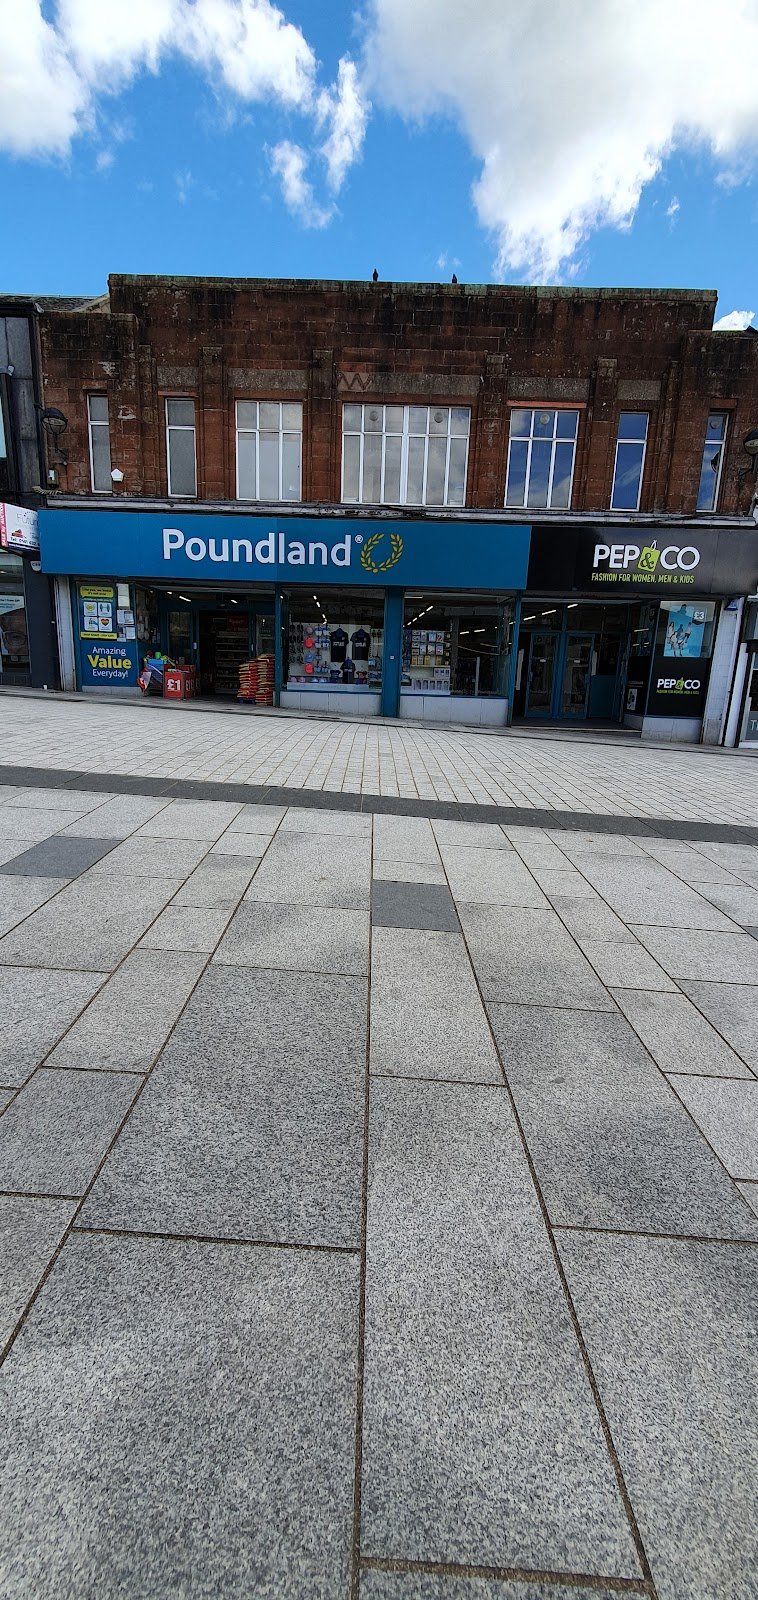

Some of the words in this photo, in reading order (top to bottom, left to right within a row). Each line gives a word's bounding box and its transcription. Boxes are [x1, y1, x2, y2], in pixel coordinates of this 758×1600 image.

[591, 573, 618, 582] FASHION
[619, 573, 631, 582] FOR
[632, 574, 657, 583] WOMEN,
[658, 574, 672, 583] MEN
[673, 575, 678, 583] &
[679, 575, 695, 584] KIDS
[693, 610, 705, 620] £3
[92, 646, 127, 657] Amazing
[87, 655, 132, 669] Value
[92, 669, 129, 679] Everyday!
[167, 678, 181, 692] £1
